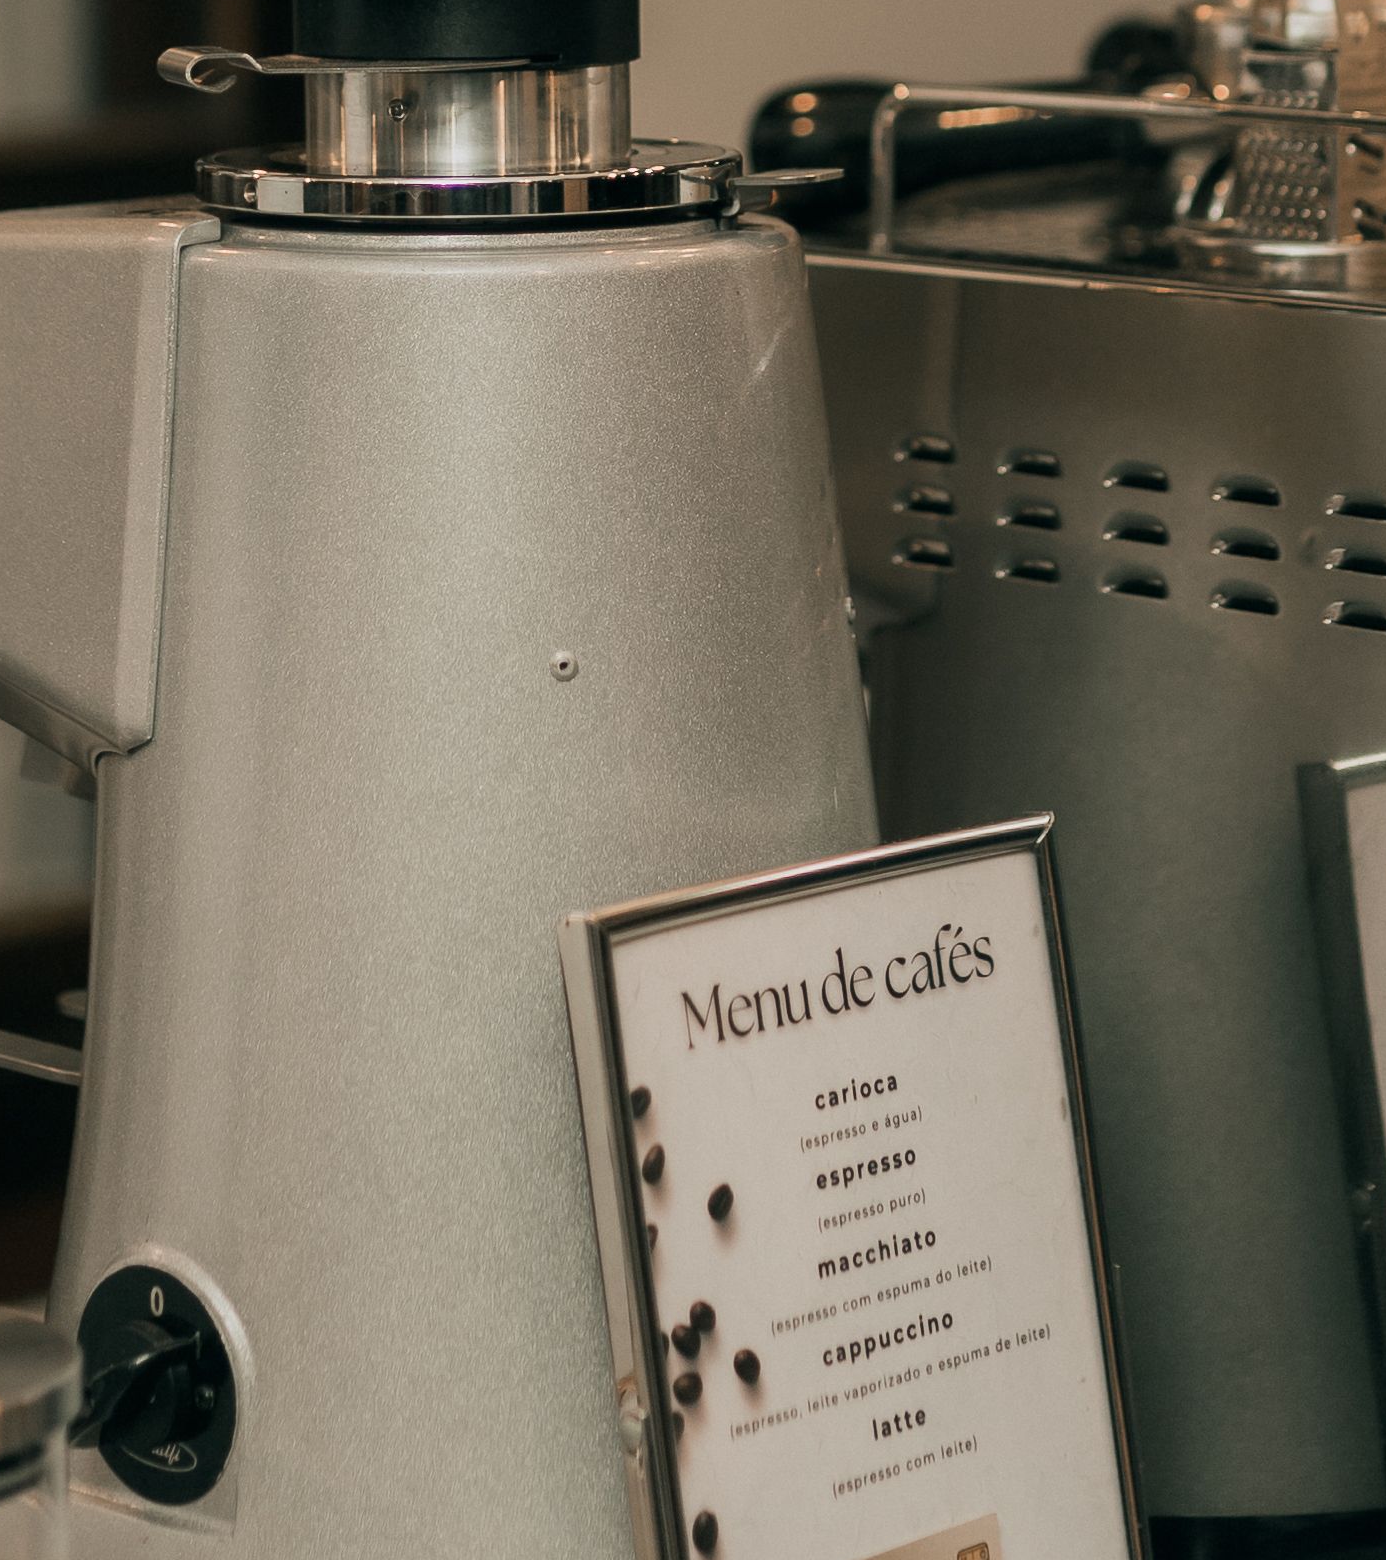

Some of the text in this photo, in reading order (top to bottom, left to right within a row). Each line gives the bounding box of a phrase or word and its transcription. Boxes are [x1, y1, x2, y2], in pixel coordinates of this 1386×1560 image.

[680, 923, 995, 1050] Menu de cafés
[814, 1075, 899, 1110] carioca
[800, 1105, 923, 1153] (espresso e água)
[815, 1149, 917, 1190] espresso
[817, 1188, 927, 1233] (espresso puro)
[817, 1230, 937, 1279] macchiato
[770, 1255, 993, 1339] (espresso com espuma do leite)
[821, 1310, 954, 1367] cappuccino
[807, 1393, 839, 1414] leite
[843, 1368, 921, 1402] vaporizado
[925, 1362, 934, 1376] e
[938, 1345, 991, 1372] espuma
[994, 1336, 1012, 1354] de
[1015, 1323, 1051, 1347] leite)
[871, 1407, 928, 1441] latte
[832, 1434, 979, 1500] (espresso com leite)
